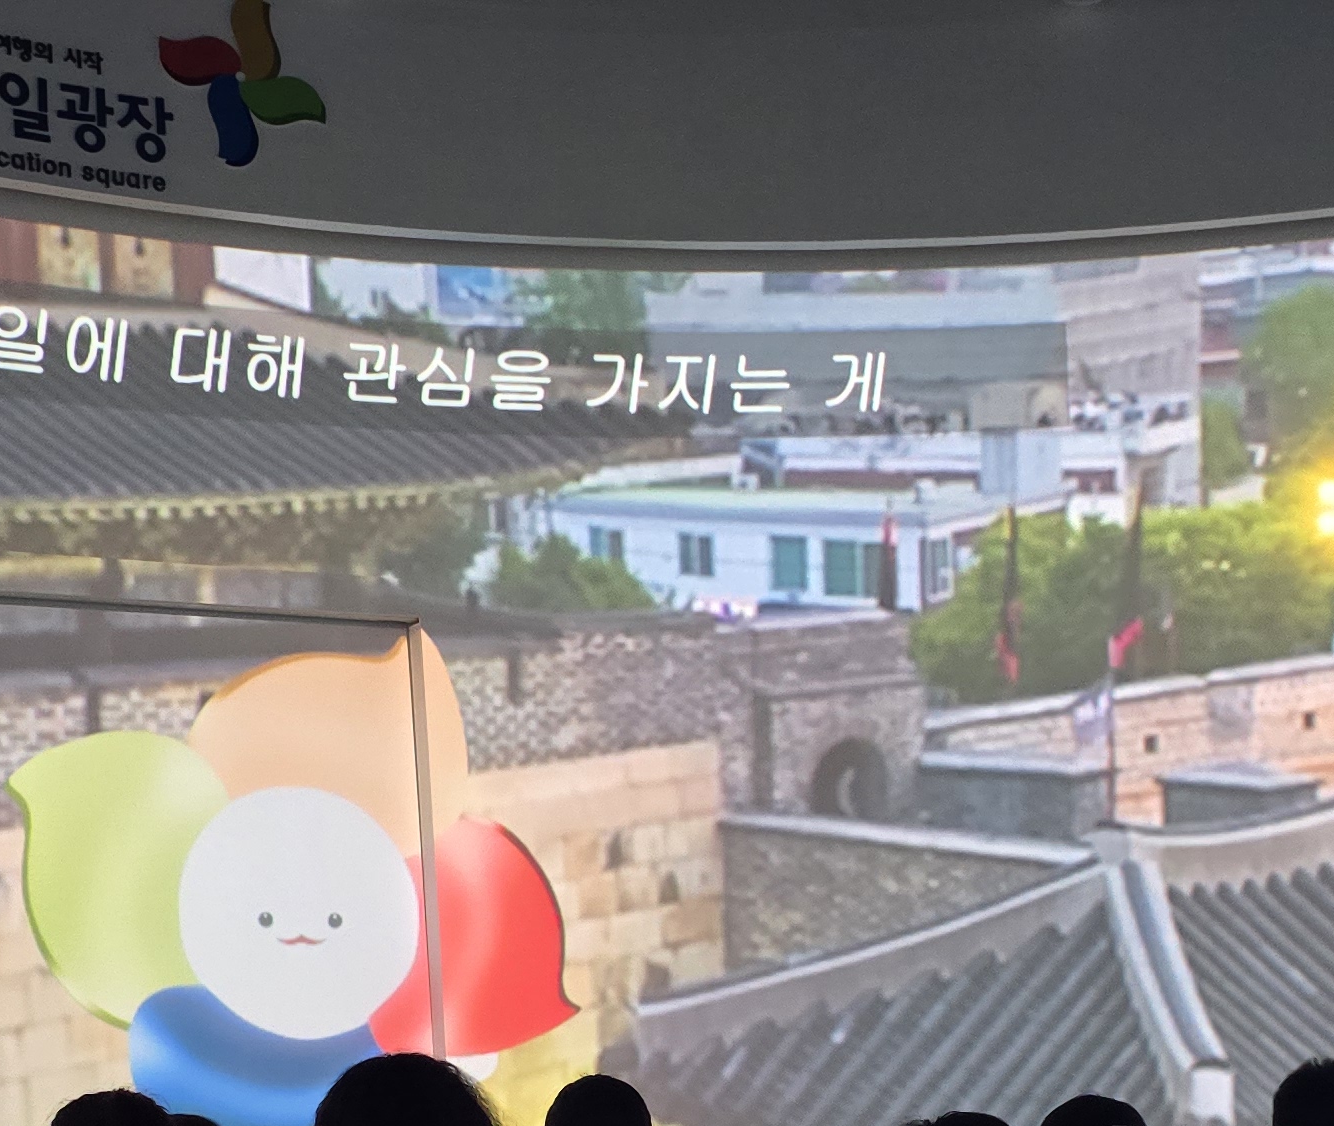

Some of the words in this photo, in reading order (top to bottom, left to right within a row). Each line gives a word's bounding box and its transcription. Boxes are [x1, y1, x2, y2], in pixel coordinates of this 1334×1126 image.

[63, 46, 104, 75] 시작
[81, 164, 167, 193] square
[169, 327, 306, 400] 대해
[342, 341, 553, 412] 관심을
[585, 352, 791, 416] 가지는
[824, 350, 887, 414] 게
